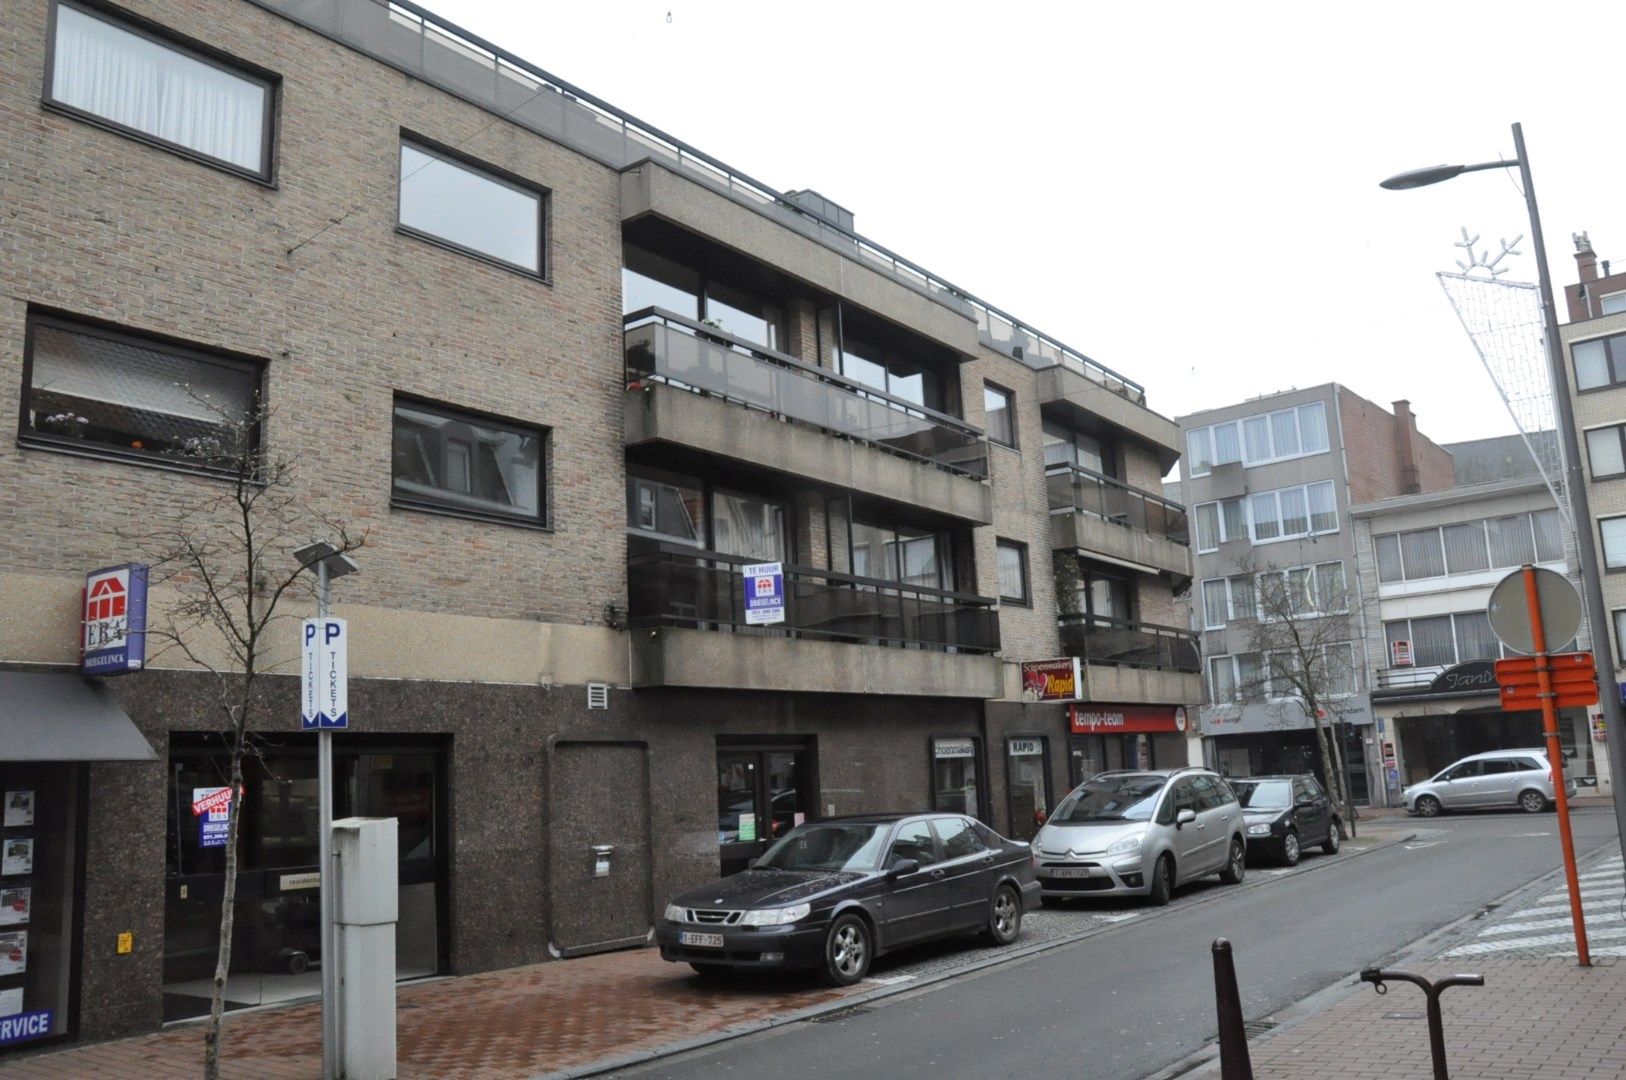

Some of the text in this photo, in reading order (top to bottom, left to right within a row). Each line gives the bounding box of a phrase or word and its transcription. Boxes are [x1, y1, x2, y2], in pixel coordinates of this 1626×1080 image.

[759, 565, 779, 573] HUUR
[306, 624, 316, 647] P
[325, 623, 341, 645] P
[1047, 674, 1074, 698] Rapid
[1075, 712, 1124, 731] tempo-team
[1013, 742, 1034, 753] RAPID
[0, 1013, 49, 1040] RVICE
